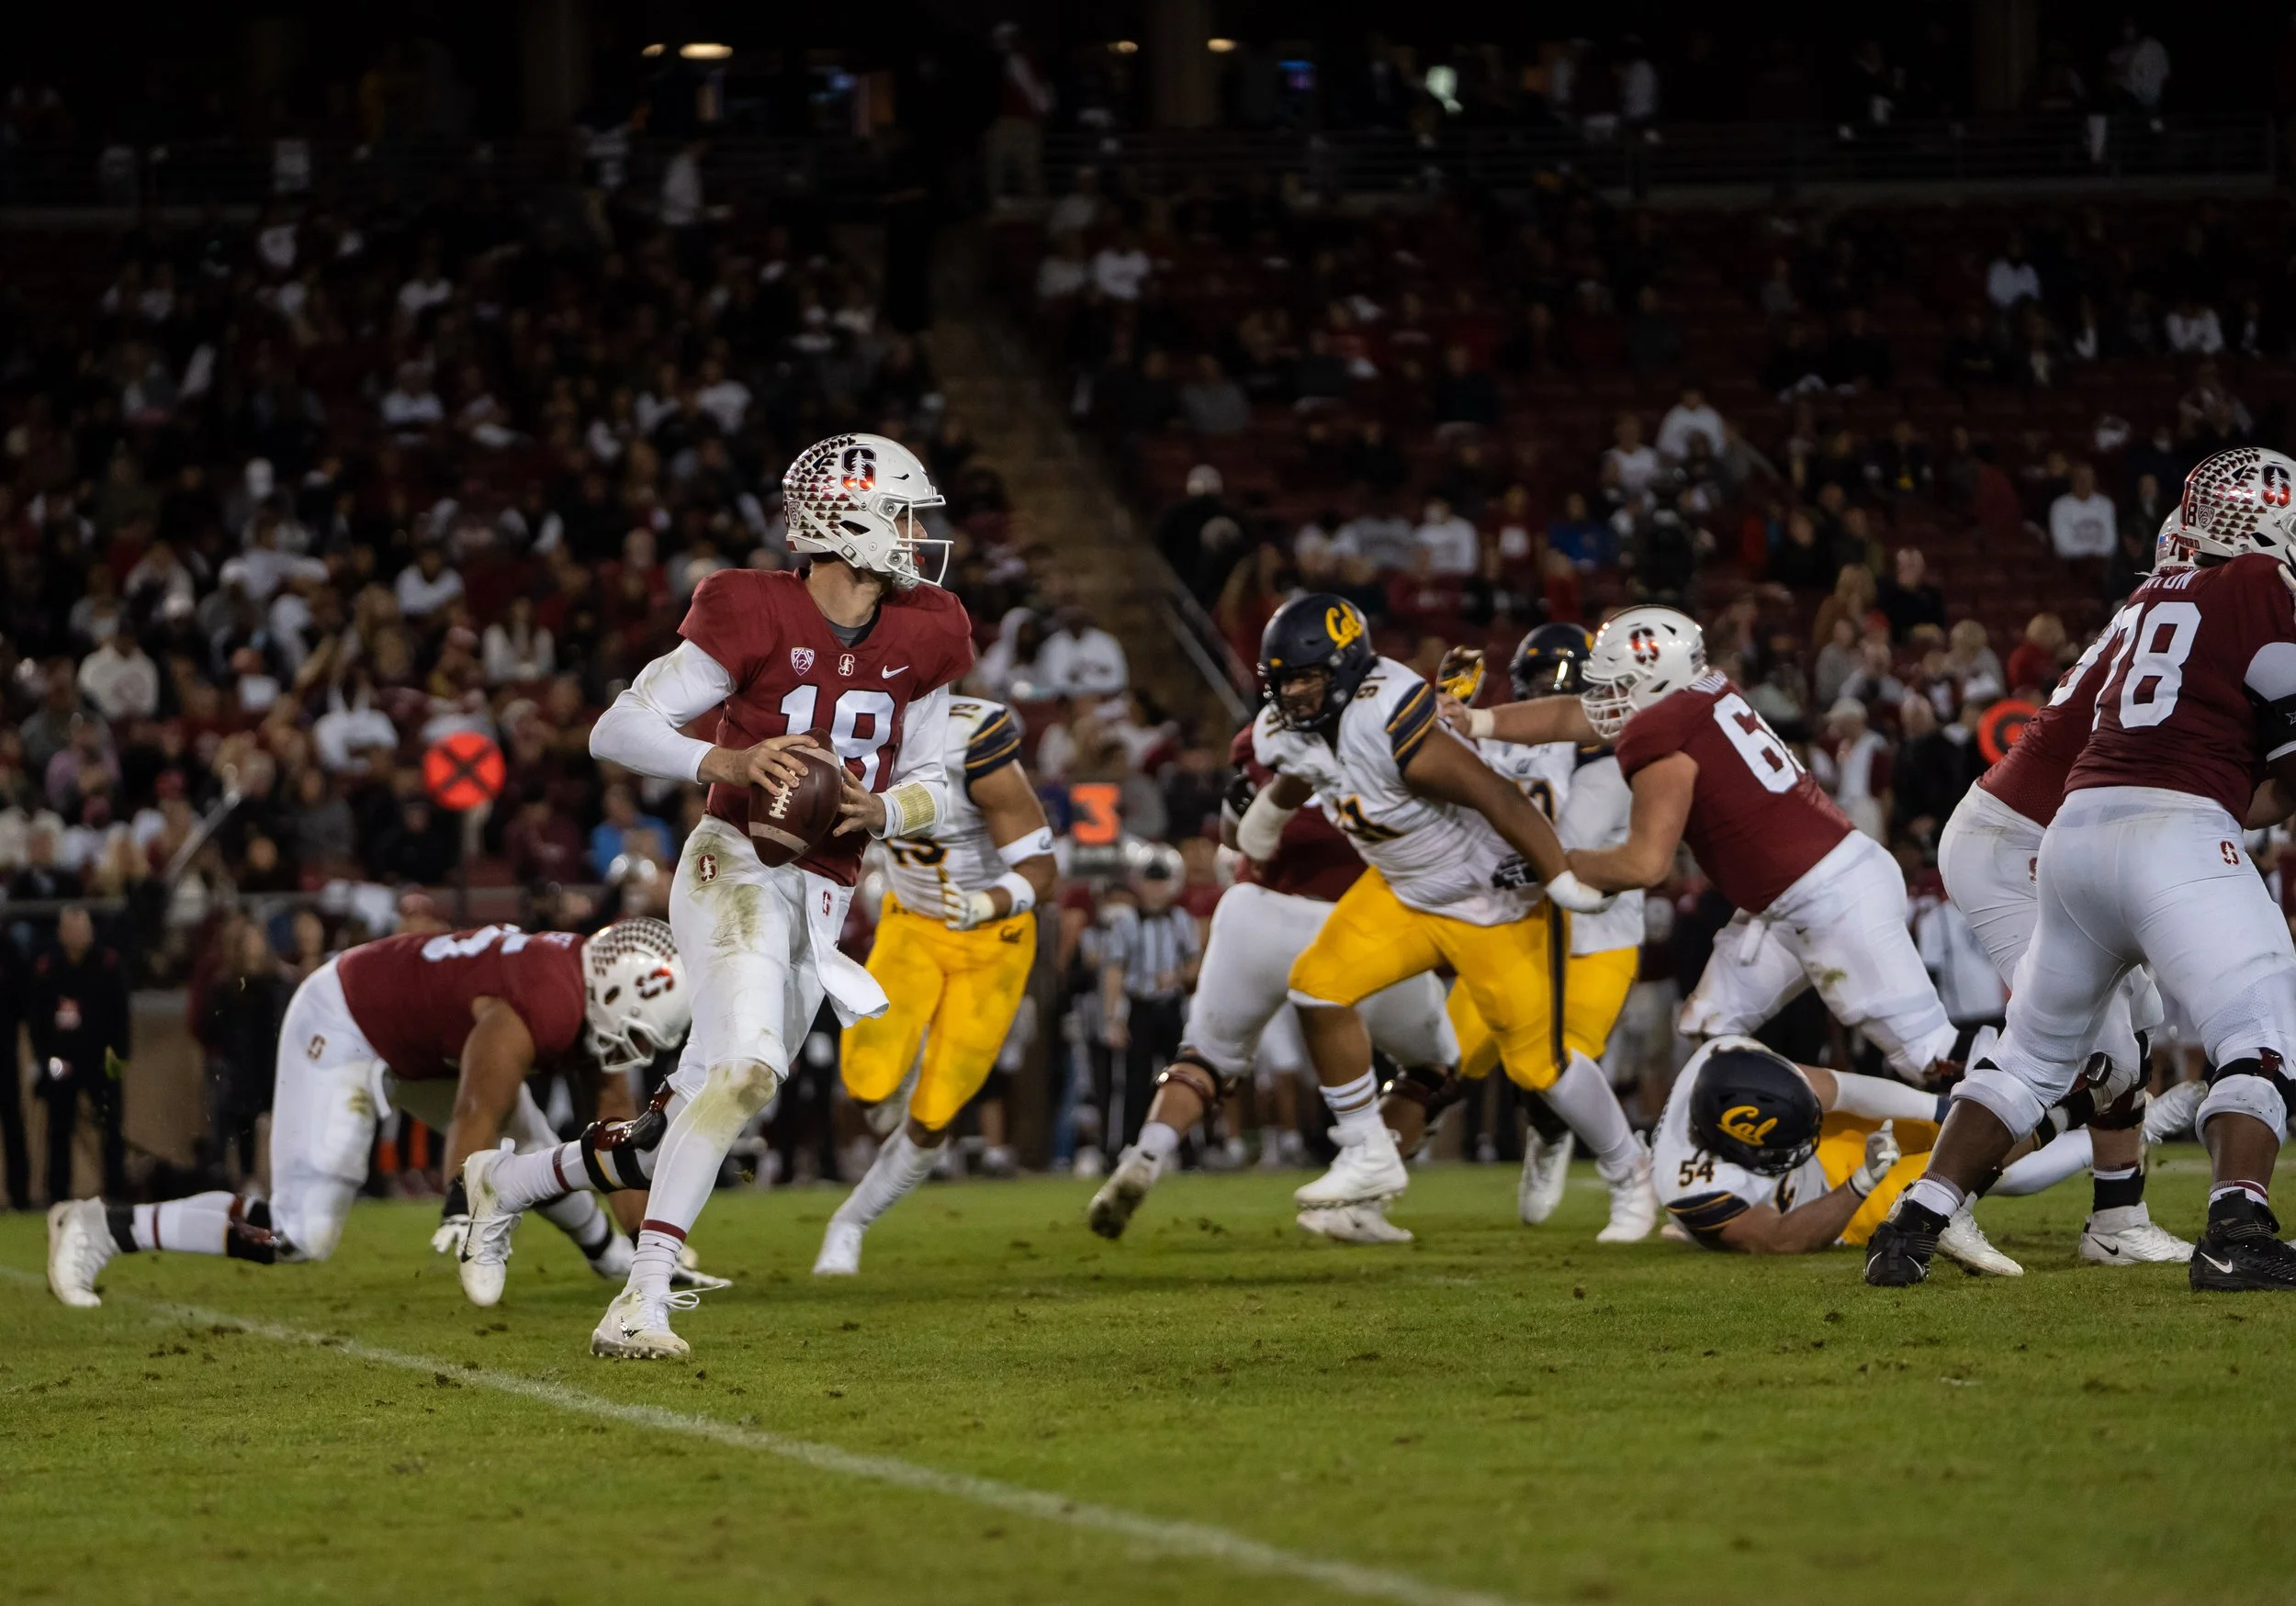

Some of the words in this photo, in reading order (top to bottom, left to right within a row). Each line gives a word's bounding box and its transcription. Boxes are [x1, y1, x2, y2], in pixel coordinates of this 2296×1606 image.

[1324, 602, 1363, 650] Cal
[792, 649, 815, 665] PAC
[795, 659, 807, 670] 12
[2092, 601, 2202, 733] 78
[780, 683, 896, 792] 18
[1713, 692, 1806, 794] 6
[1071, 784, 1120, 844] 3
[1716, 1105, 1779, 1147] Cal
[1678, 1159, 1715, 1187] 54
